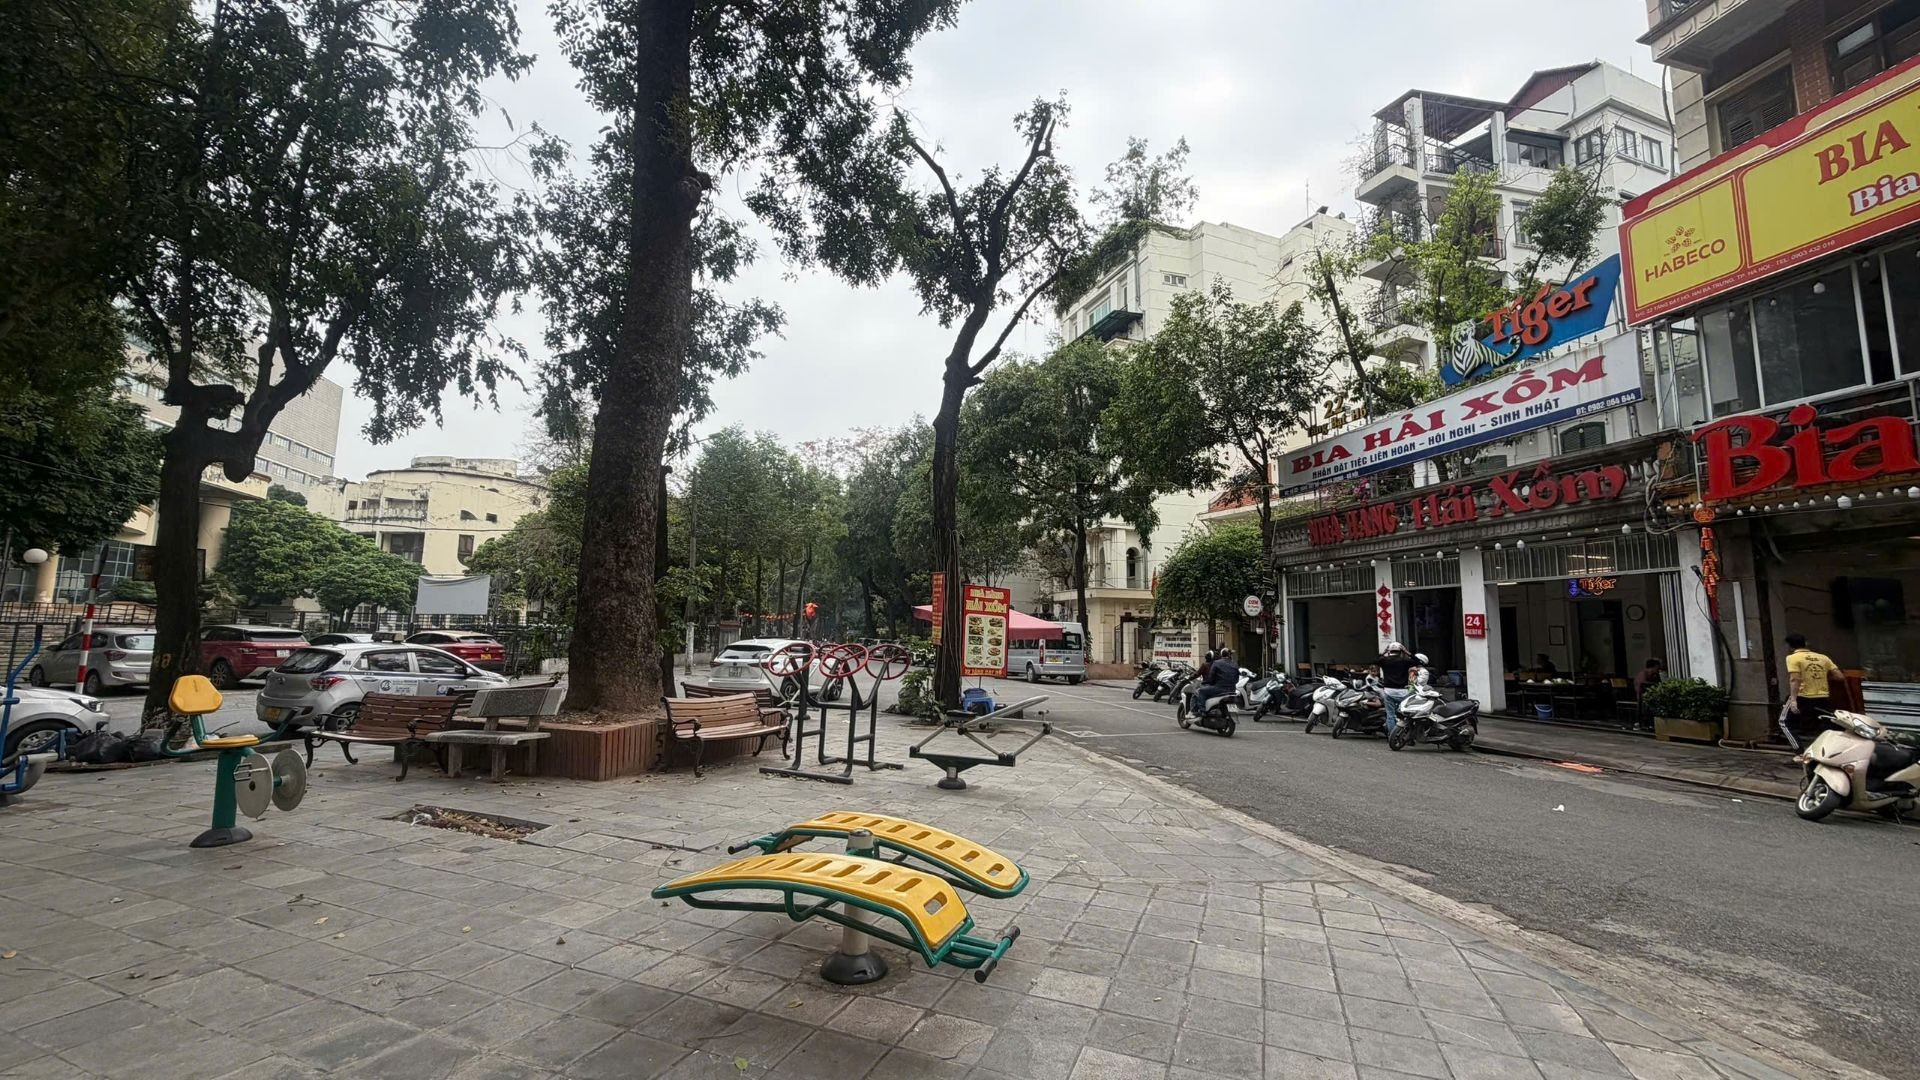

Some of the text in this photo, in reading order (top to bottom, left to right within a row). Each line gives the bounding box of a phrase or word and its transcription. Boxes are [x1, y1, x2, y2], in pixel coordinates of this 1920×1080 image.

[1815, 120, 1911, 185] BIA
[1849, 171, 1920, 216] Bia
[1645, 238, 1726, 282] HABECO
[1484, 276, 1597, 345] Tiger
[1291, 355, 1608, 474] BIA HẢI XỒM
[1323, 395, 1344, 419] 22
[1391, 442, 1416, 457] HOAN
[1490, 409, 1521, 427] SINH
[1525, 397, 1560, 417] NHẬT
[1689, 403, 1920, 500] Bia
[1308, 507, 1345, 546] NHÀ
[1345, 496, 1399, 541] HÀNG
[1411, 484, 1478, 530] Hải
[1488, 458, 1628, 517] Xồm
[1466, 616, 1481, 627] 24
